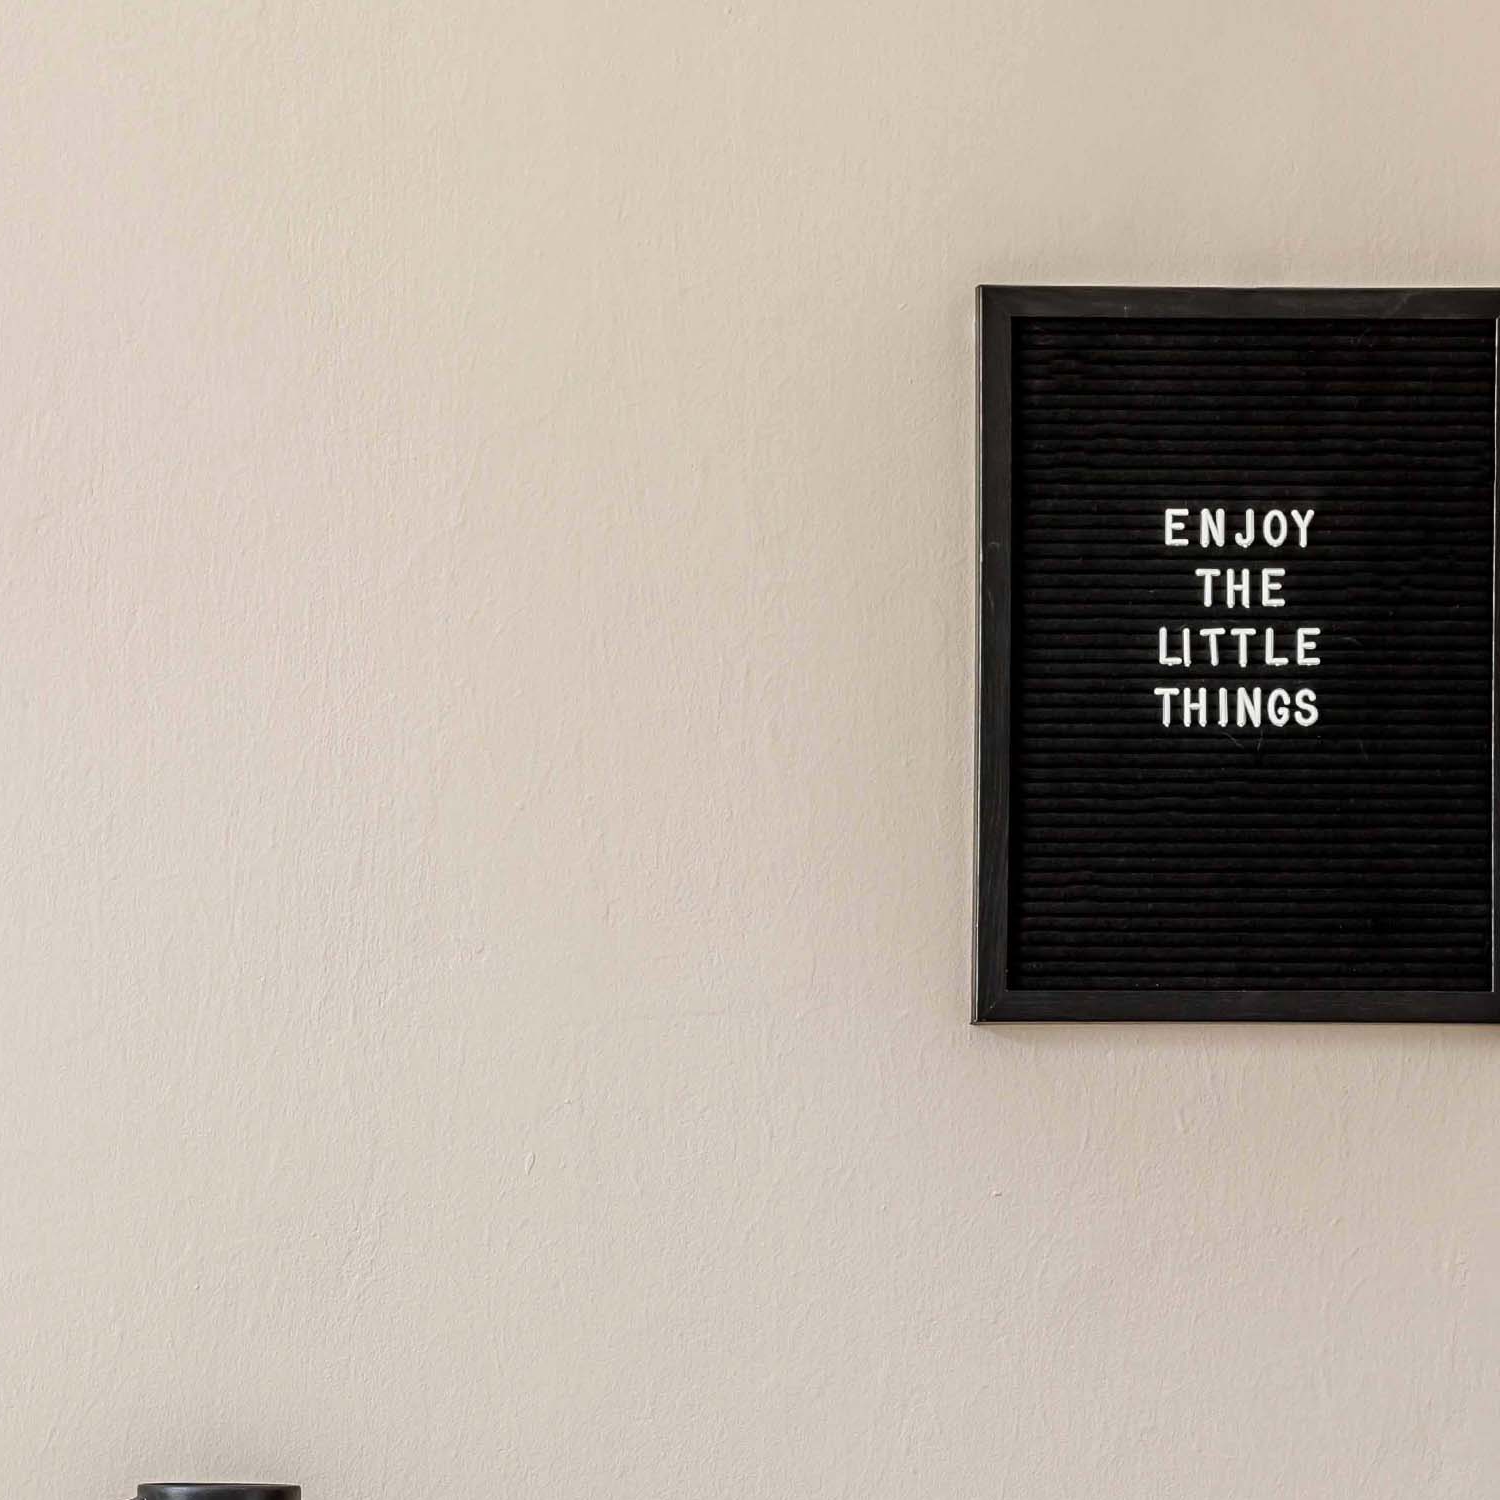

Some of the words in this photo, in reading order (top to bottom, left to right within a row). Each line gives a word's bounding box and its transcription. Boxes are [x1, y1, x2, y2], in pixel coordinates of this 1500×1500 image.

[1164, 507, 1314, 548] ENJOY
[1194, 567, 1286, 608] THE
[1158, 626, 1320, 667] LITTLE
[1153, 686, 1319, 727] THINGS
